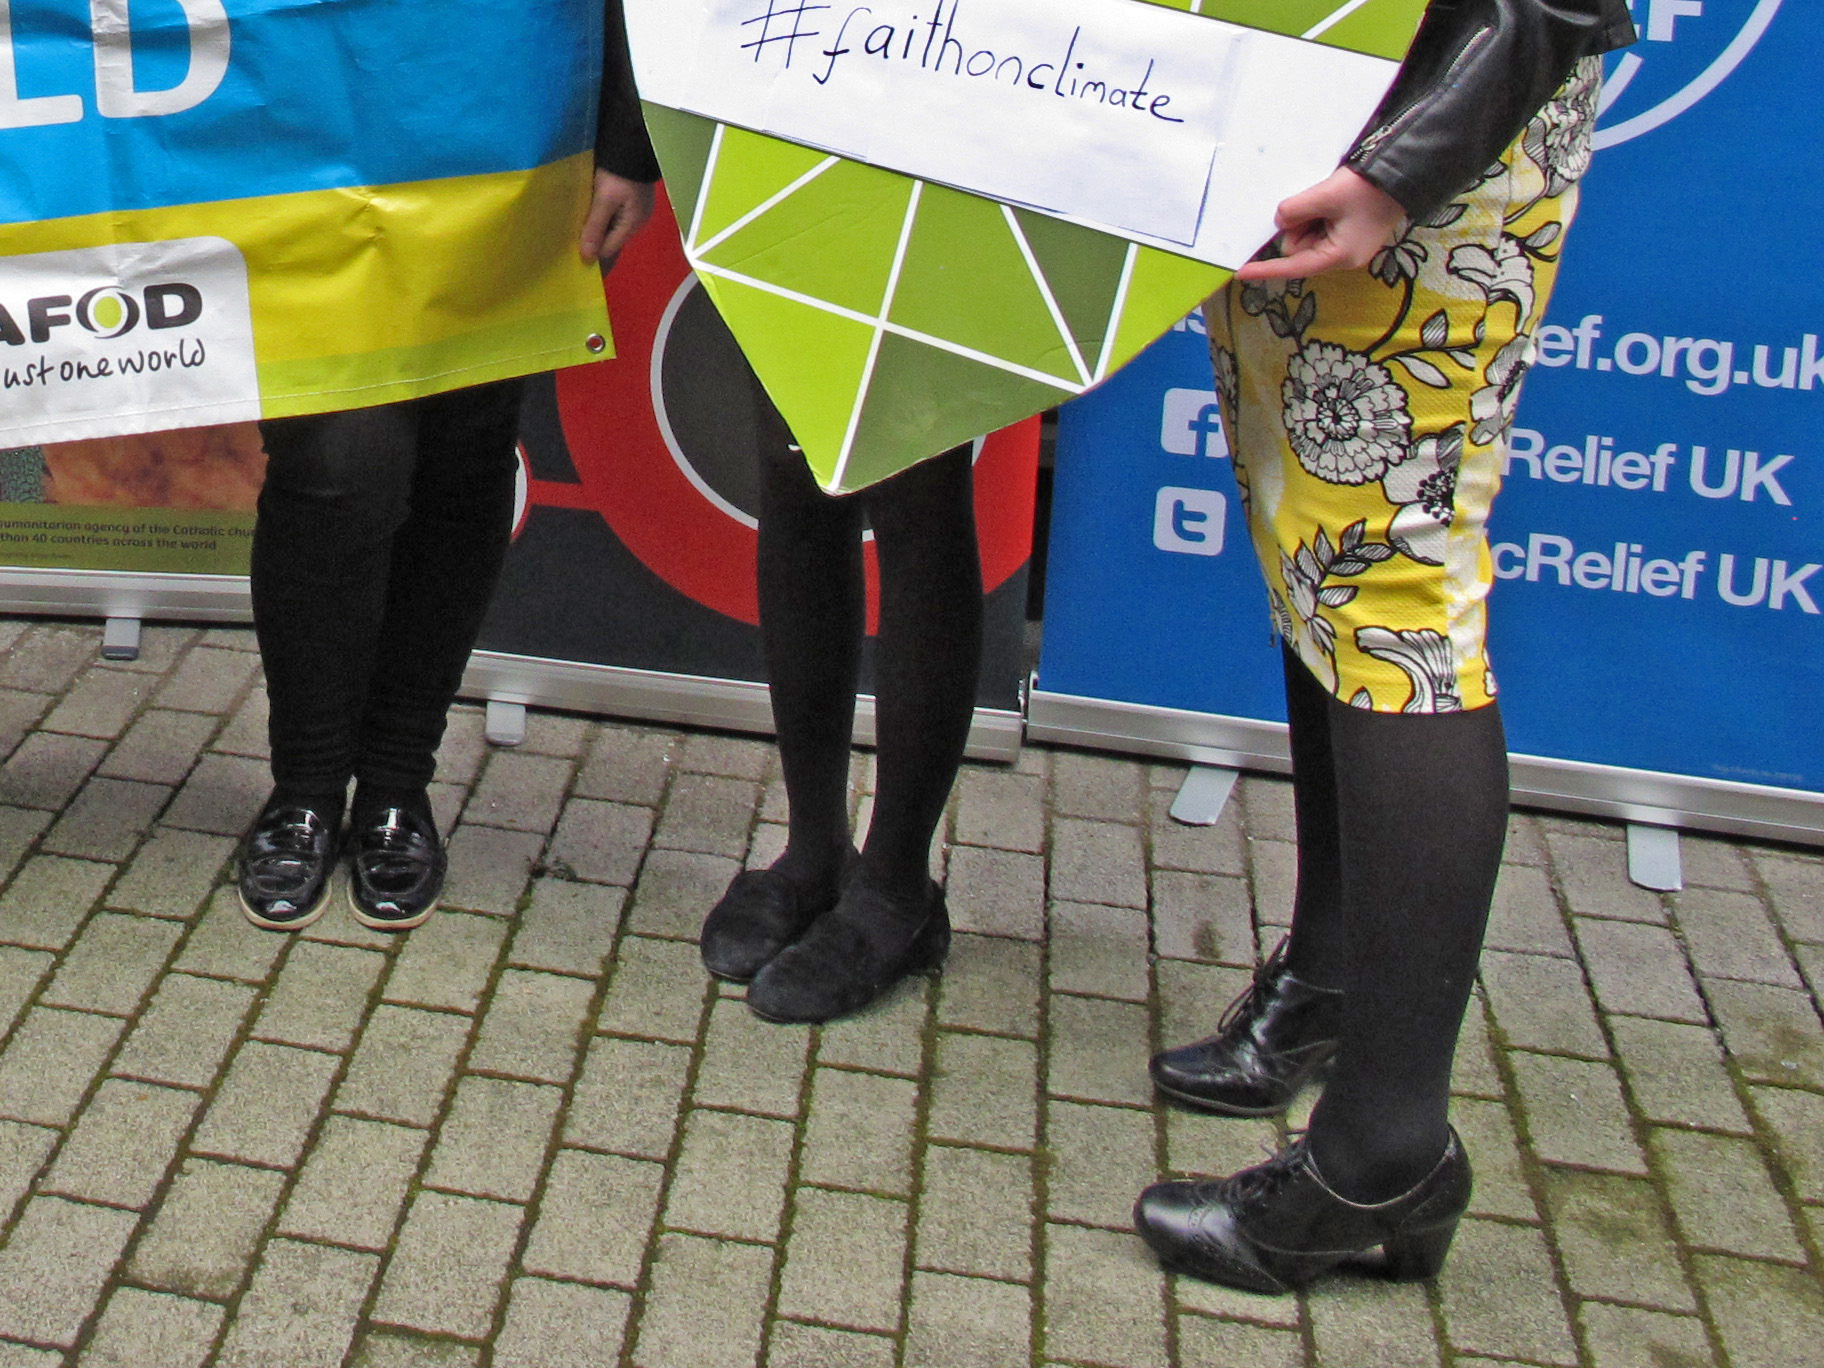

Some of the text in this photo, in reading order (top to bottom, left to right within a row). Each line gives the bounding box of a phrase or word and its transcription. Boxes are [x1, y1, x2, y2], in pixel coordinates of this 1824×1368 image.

[1689, 445, 1795, 507] UK
[0, 533, 28, 542] than
[32, 534, 46, 543] 40
[50, 536, 108, 546] countries
[180, 540, 215, 550] world
[84, 521, 128, 533] agency
[1717, 552, 1823, 615] UK
